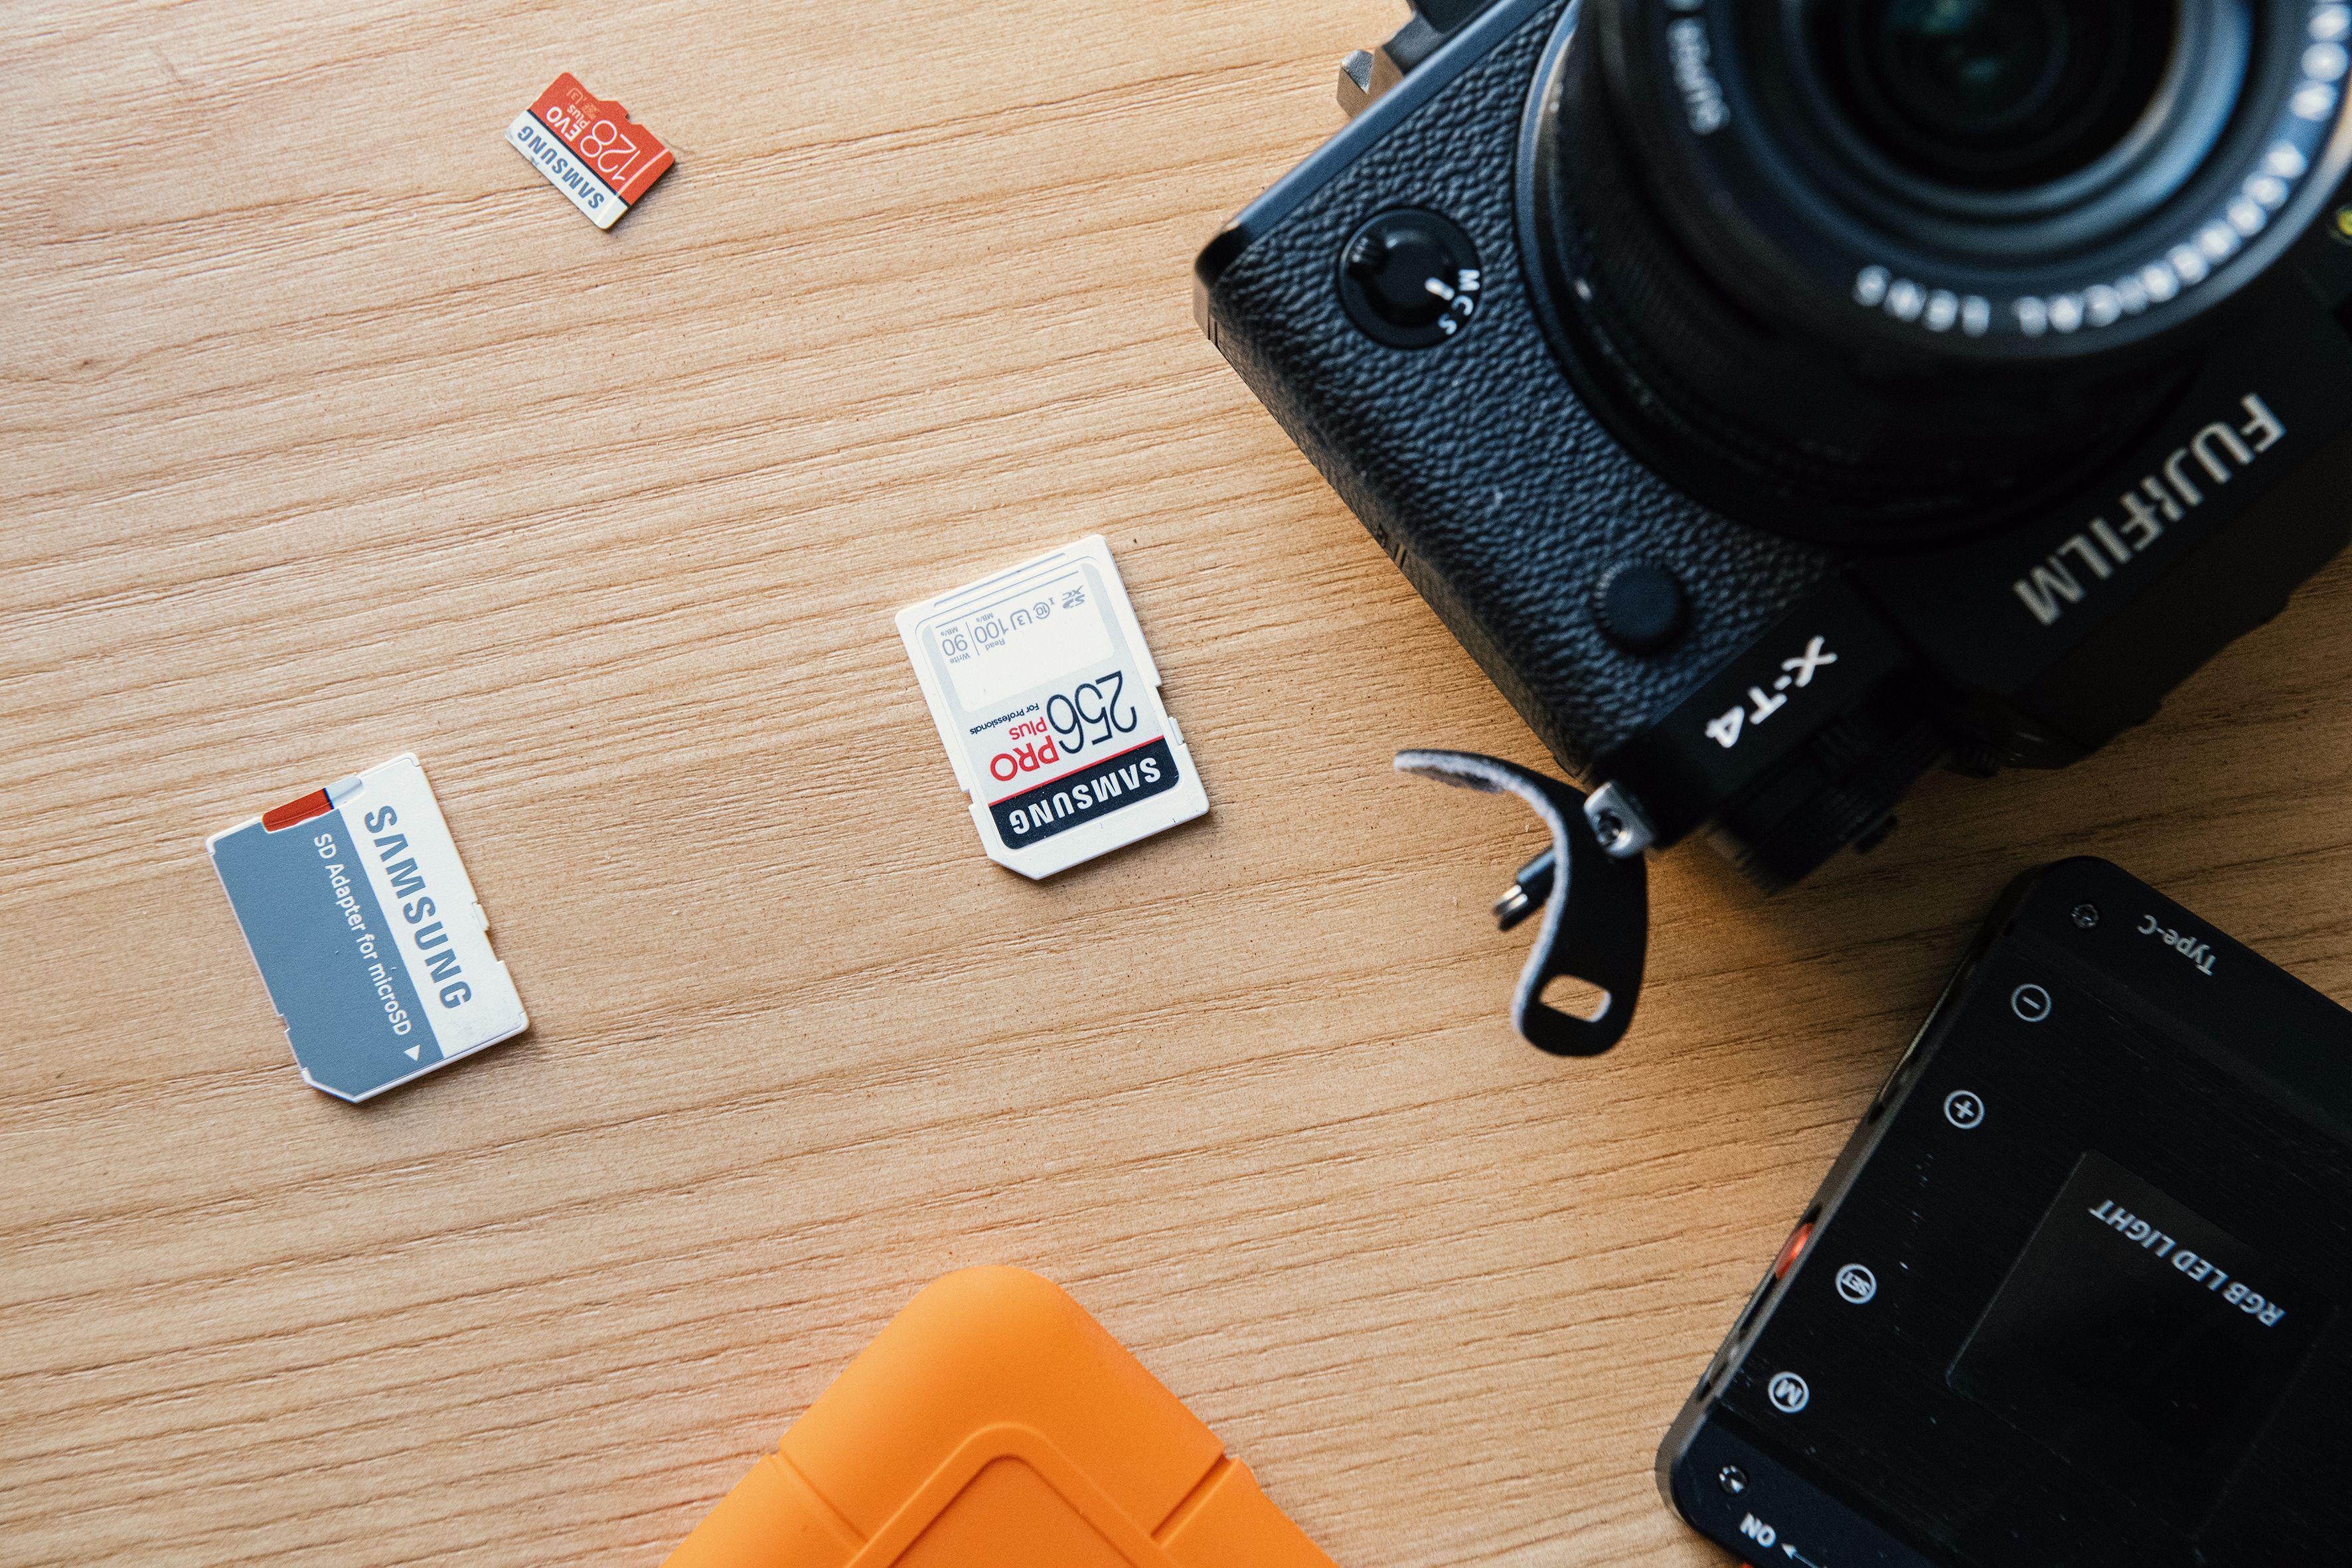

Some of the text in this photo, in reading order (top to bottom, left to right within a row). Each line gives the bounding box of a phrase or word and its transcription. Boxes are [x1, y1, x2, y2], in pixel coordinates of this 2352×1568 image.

[546, 106, 582, 142] EVO
[567, 104, 591, 129] Plus
[518, 126, 605, 209] SAMSUNG
[580, 119, 641, 181] 128
[1438, 269, 1480, 335] M C S
[2011, 392, 2287, 627] FUJIFILM
[941, 626, 959, 637] MB/s
[974, 618, 1009, 644] 100
[976, 612, 994, 623] MB/s
[942, 633, 968, 657] 90
[949, 652, 971, 664] Write
[984, 638, 1006, 652] Read
[1046, 670, 1137, 753] 256
[1705, 635, 1838, 748] X-T4
[969, 702, 1040, 735] For Professionals
[1008, 716, 1048, 740] Plus
[990, 735, 1059, 782] PRO
[1009, 757, 1161, 834] SAMSUNG
[364, 805, 472, 1009] SAMSUNG
[313, 832, 413, 1036] SD Adapter for microSD
[2137, 914, 2216, 977] Type-C
[2088, 1199, 2287, 1328] RGB LED LIGHT
[1739, 1512, 1776, 1548] ON
